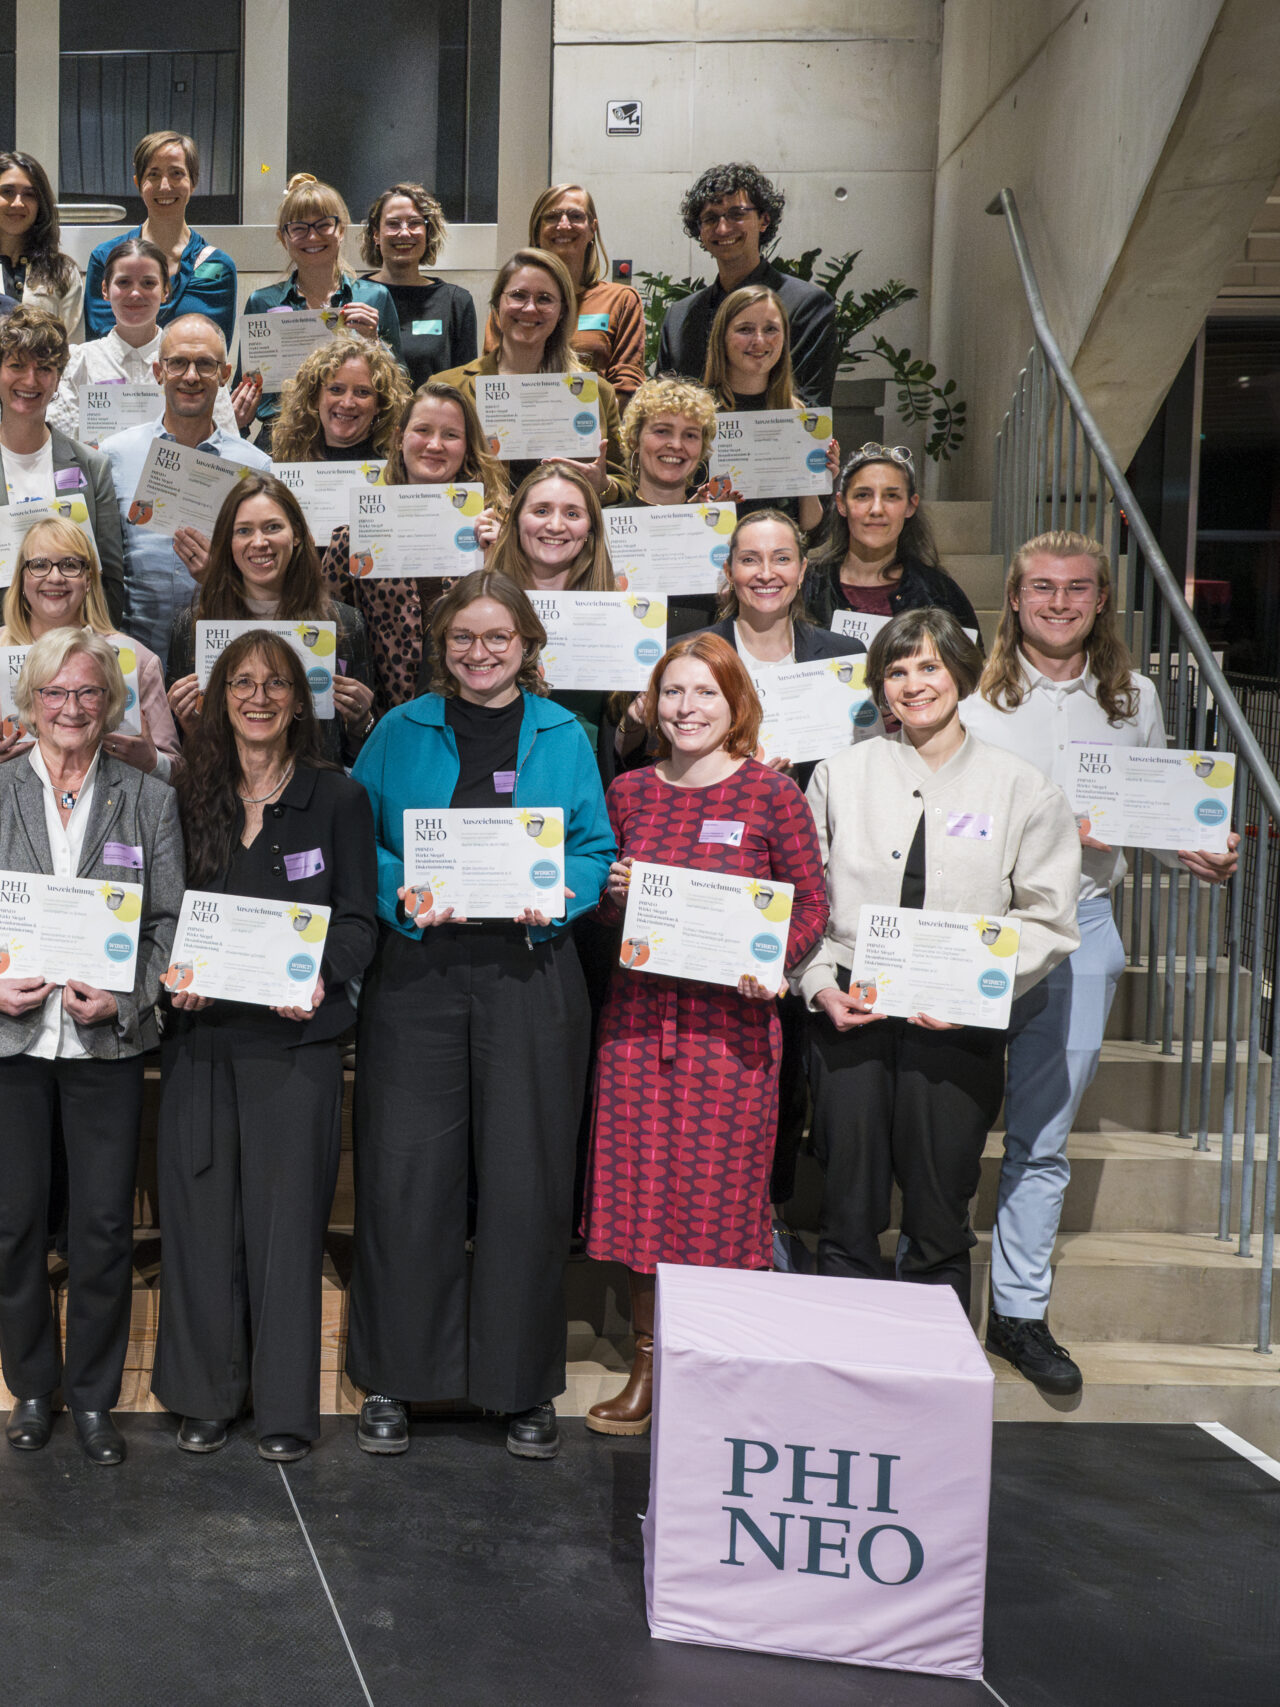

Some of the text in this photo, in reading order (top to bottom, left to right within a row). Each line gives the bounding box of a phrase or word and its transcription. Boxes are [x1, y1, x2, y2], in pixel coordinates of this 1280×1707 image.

[247, 320, 267, 329] PHI
[247, 328, 271, 338] NEO
[484, 382, 506, 391] PHI
[87, 392, 108, 400] PHI
[484, 391, 509, 400] NEO
[87, 400, 111, 408] NEO
[718, 420, 739, 430] PHI
[718, 429, 743, 439] NEO
[157, 446, 181, 462] PHI
[154, 456, 181, 472] NEO
[358, 494, 382, 504] PHI
[358, 504, 385, 514] NEO
[609, 515, 633, 525] PHI
[609, 524, 637, 535] NEO
[574, 599, 621, 607] Auszeichnung
[841, 618, 868, 631] PHI
[205, 629, 230, 638] PHI
[776, 670, 824, 681] Auszeichnung
[1078, 751, 1108, 763] PHI
[1128, 755, 1182, 765] Auszeichnung
[1077, 762, 1112, 774] NEO
[415, 818, 443, 829] PHI
[462, 817, 513, 825] Auszeichnung
[415, 830, 447, 840] NEO
[641, 871, 671, 886] PHI
[0, 879, 28, 892] PHI
[46, 883, 95, 896] Auszeichnung
[639, 883, 673, 898] NEO
[690, 878, 742, 894] Auszeichnung
[0, 891, 31, 904] NEO
[191, 899, 219, 912] PHI
[235, 904, 283, 917] Auszeichnung
[189, 910, 220, 924] NEO
[869, 913, 898, 927] PHI
[917, 918, 969, 931] Auszeichnung
[867, 925, 901, 939] NEO
[722, 1437, 901, 1515] PHI
[720, 1506, 925, 1586] NEO
